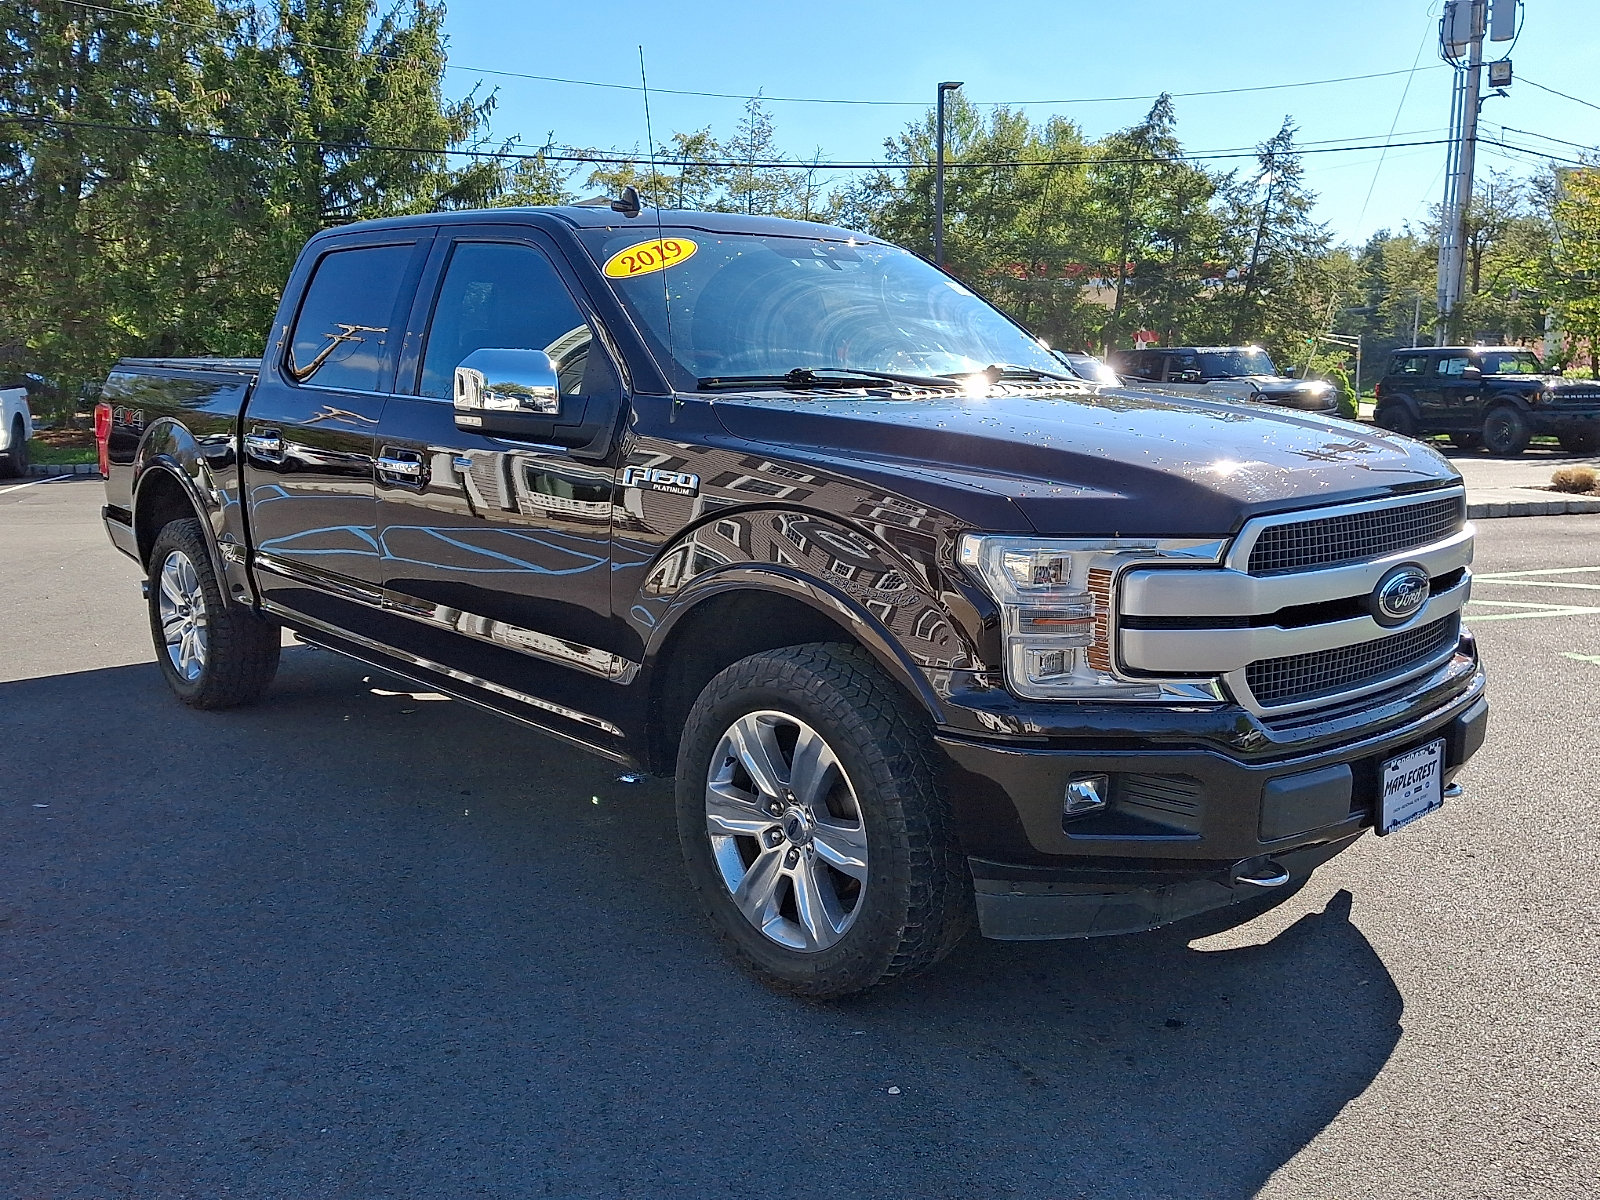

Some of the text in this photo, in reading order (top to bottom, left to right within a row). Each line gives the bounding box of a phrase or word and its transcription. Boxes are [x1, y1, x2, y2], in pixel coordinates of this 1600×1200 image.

[621, 241, 682, 273] 2019
[653, 483, 690, 496] PLATINUM
[1394, 581, 1423, 609] Ford
[1383, 760, 1438, 797] MAPLECREST
